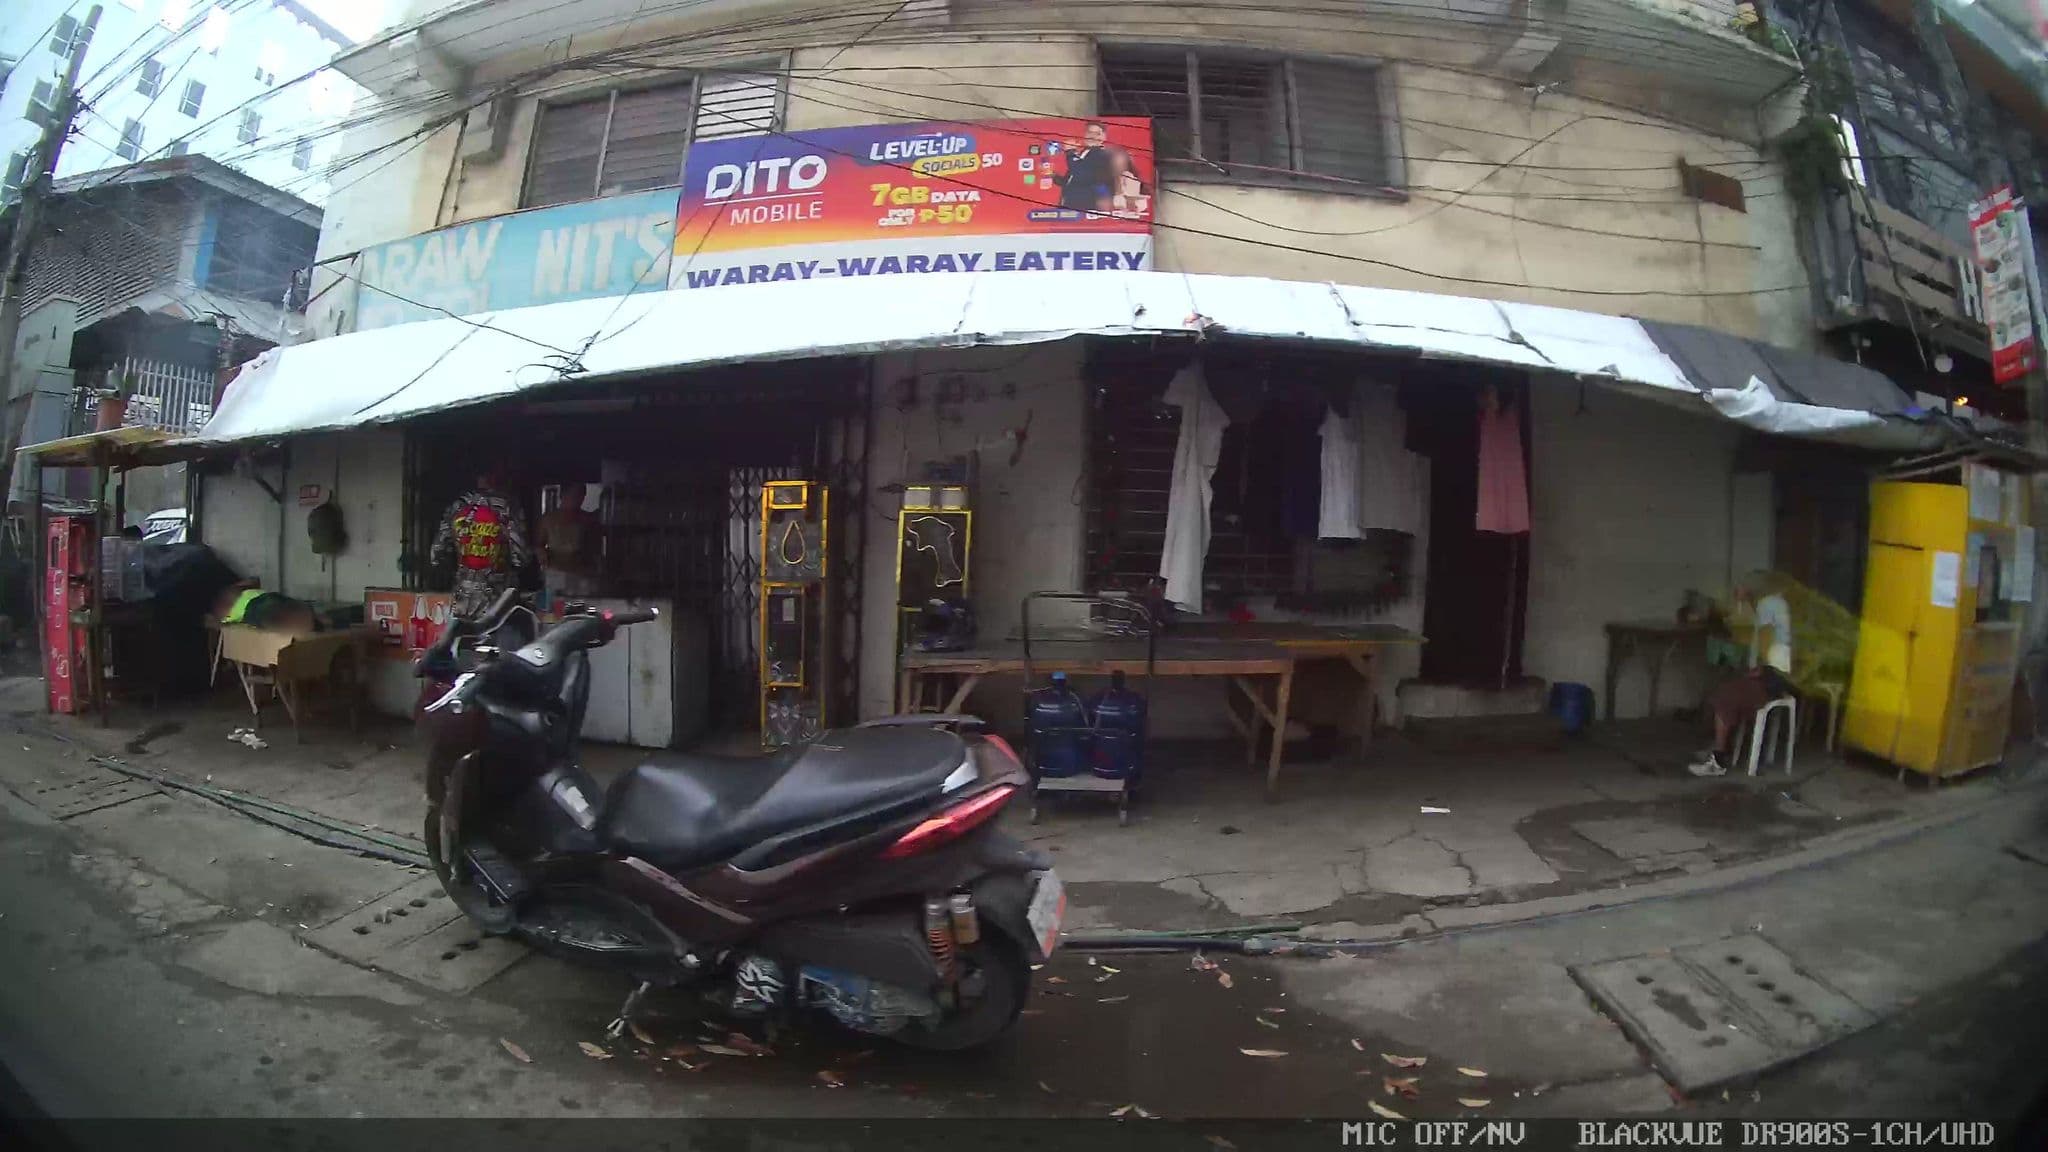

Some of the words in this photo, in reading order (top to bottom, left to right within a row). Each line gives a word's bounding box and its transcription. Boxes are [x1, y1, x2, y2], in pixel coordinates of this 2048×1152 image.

[869, 137, 968, 161] LEVEL-UP
[921, 157, 976, 174] SOCIALS
[981, 153, 1003, 169] 50
[704, 155, 828, 199] DITO
[870, 183, 930, 207] 7GB
[930, 191, 981, 203] DATA
[729, 201, 824, 227] MOBILE
[531, 211, 675, 297] NIT'S
[686, 252, 983, 290] WARAY-WARAY
[994, 250, 1147, 271] EATERY
